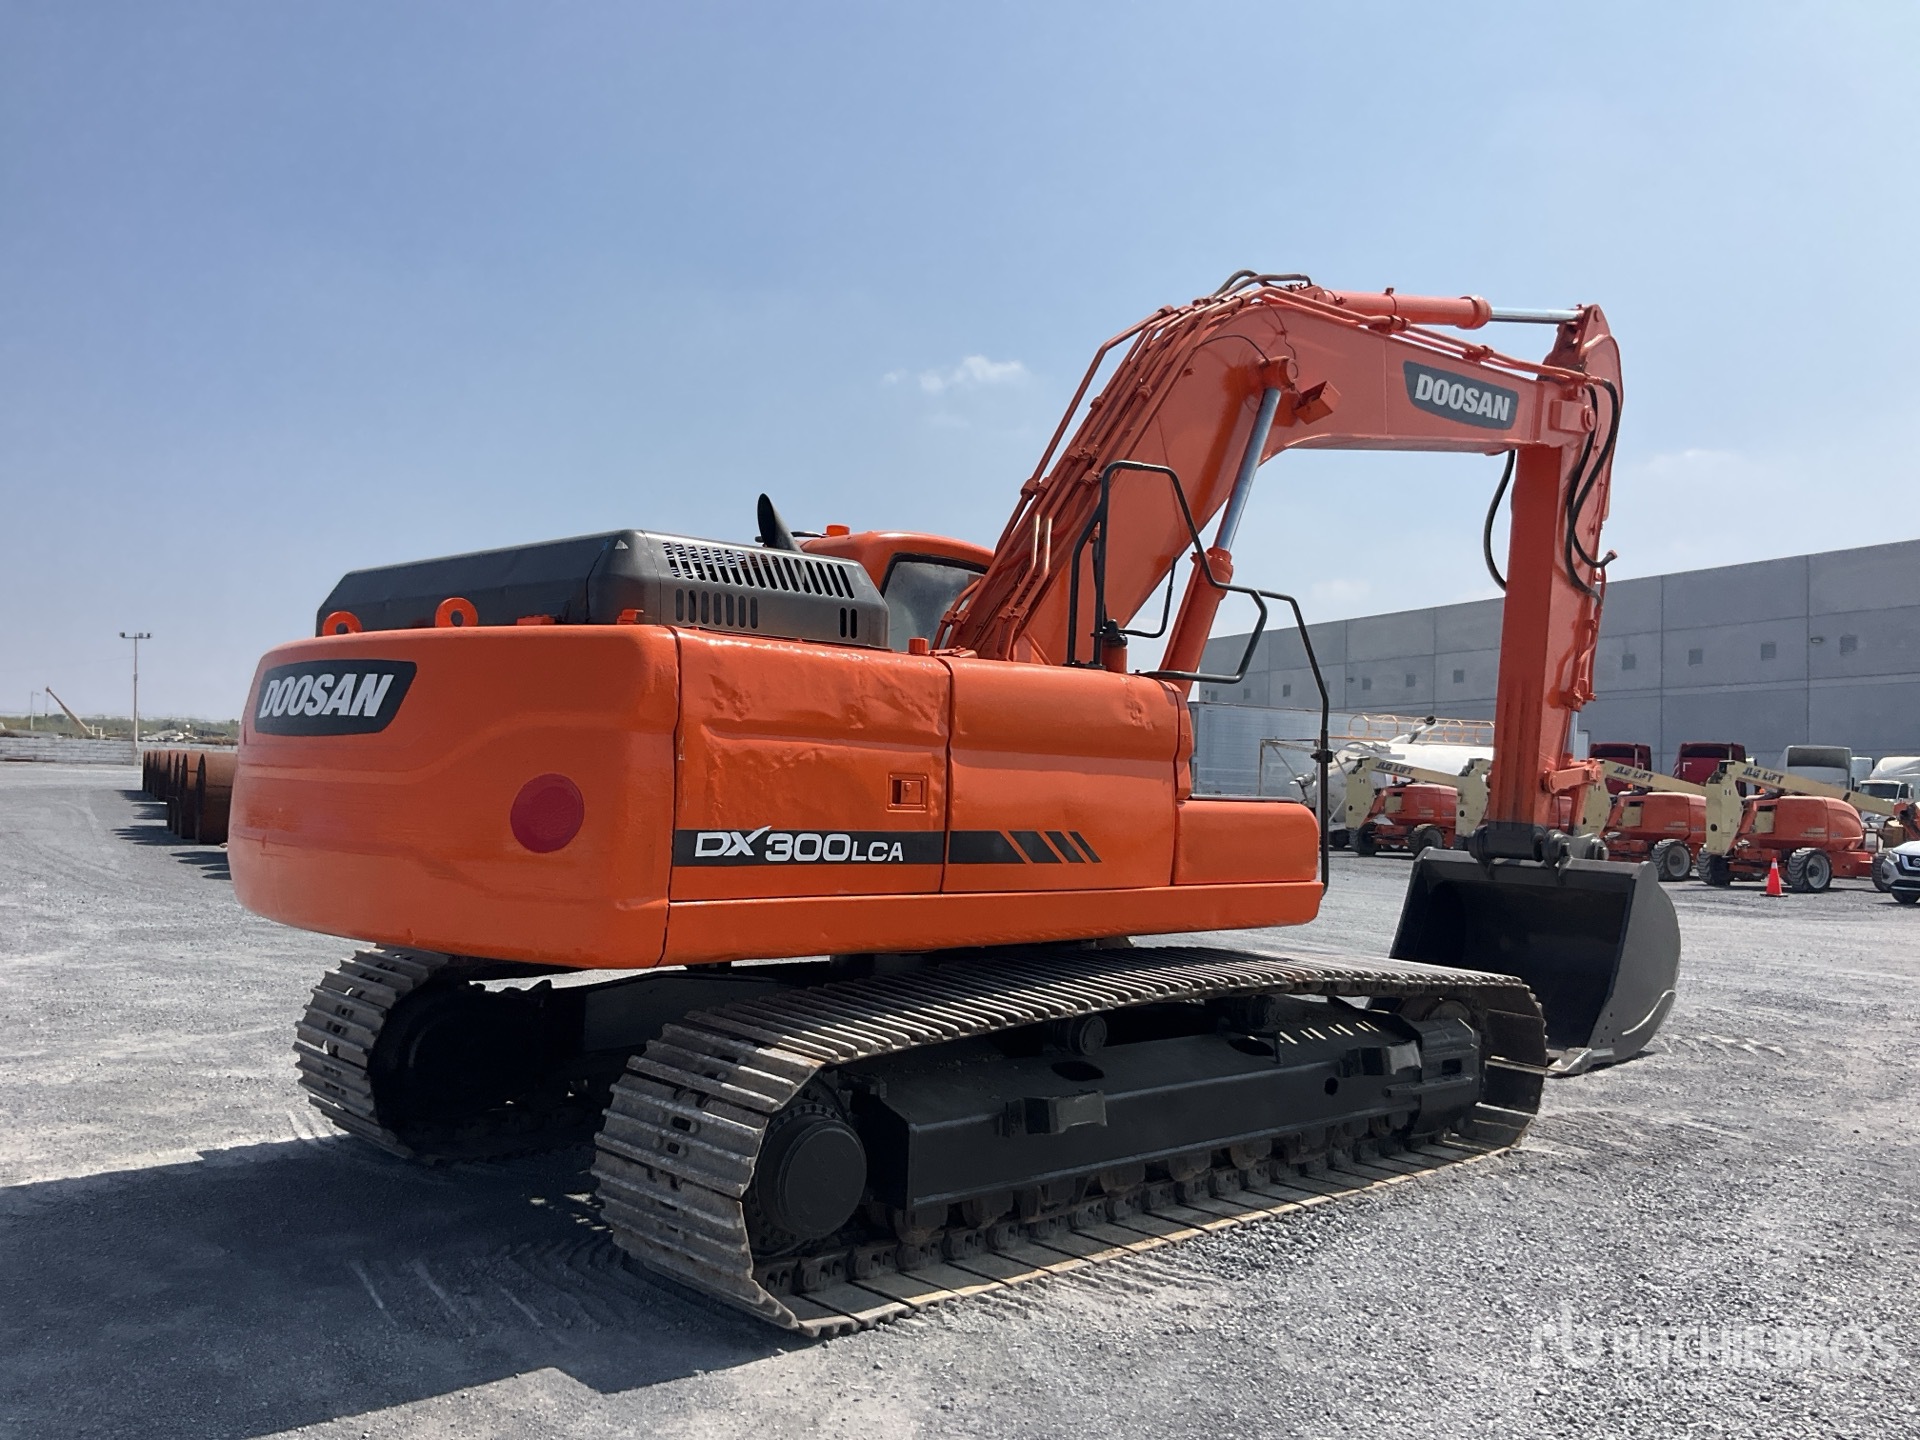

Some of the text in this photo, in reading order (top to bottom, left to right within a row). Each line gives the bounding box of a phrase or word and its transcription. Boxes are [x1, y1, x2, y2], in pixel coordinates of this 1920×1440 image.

[1415, 373, 1510, 422] DOOSAN
[259, 673, 394, 718] DOOSAN
[1376, 762, 1415, 775] JLG LIFT
[1613, 766, 1654, 782] JLG LIFT
[1743, 767, 1784, 784] JLG LIFT
